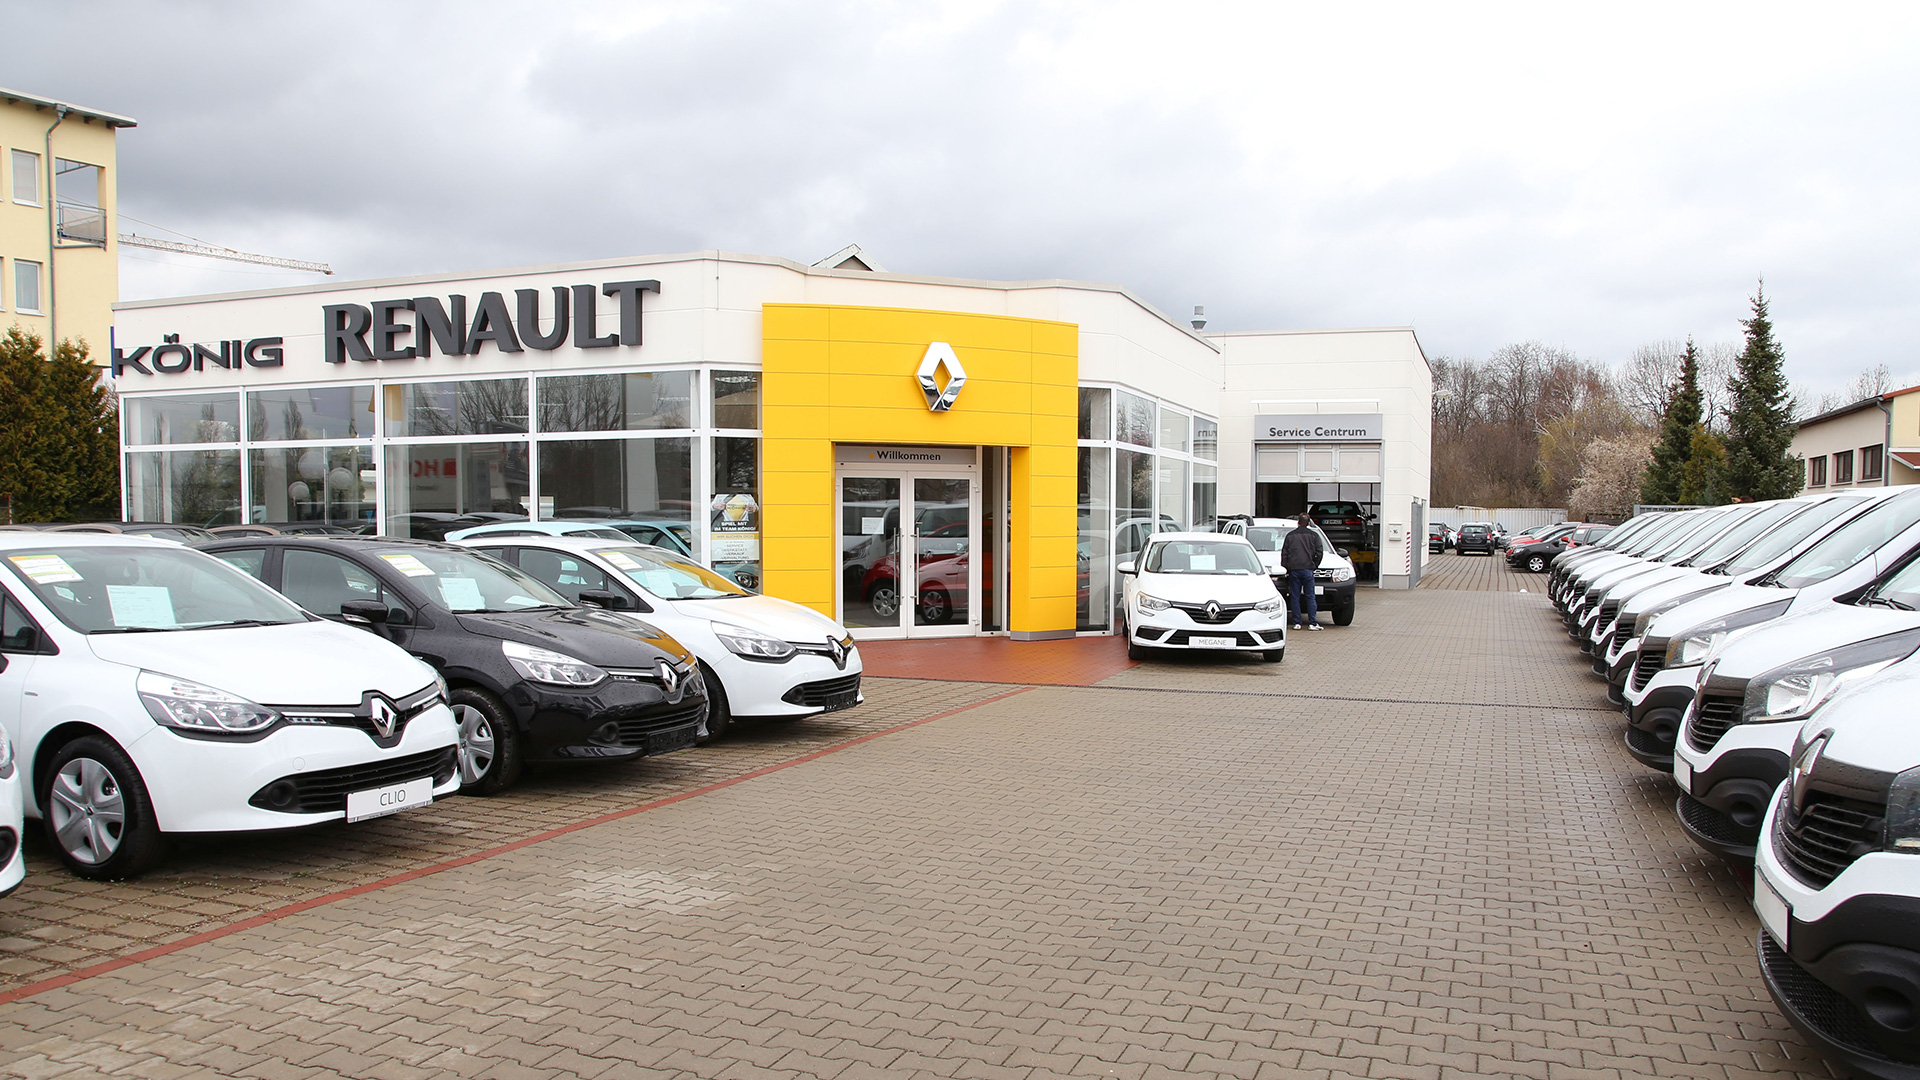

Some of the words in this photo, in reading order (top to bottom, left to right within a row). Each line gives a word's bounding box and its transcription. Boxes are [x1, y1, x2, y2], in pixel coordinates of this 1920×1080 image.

[322, 280, 661, 364] RENAULT
[113, 333, 284, 376] KÖNIG
[1269, 427, 1311, 437] Service
[1314, 427, 1367, 437] Centrum
[876, 450, 941, 461] Willkommen
[380, 789, 406, 806] CLIO
